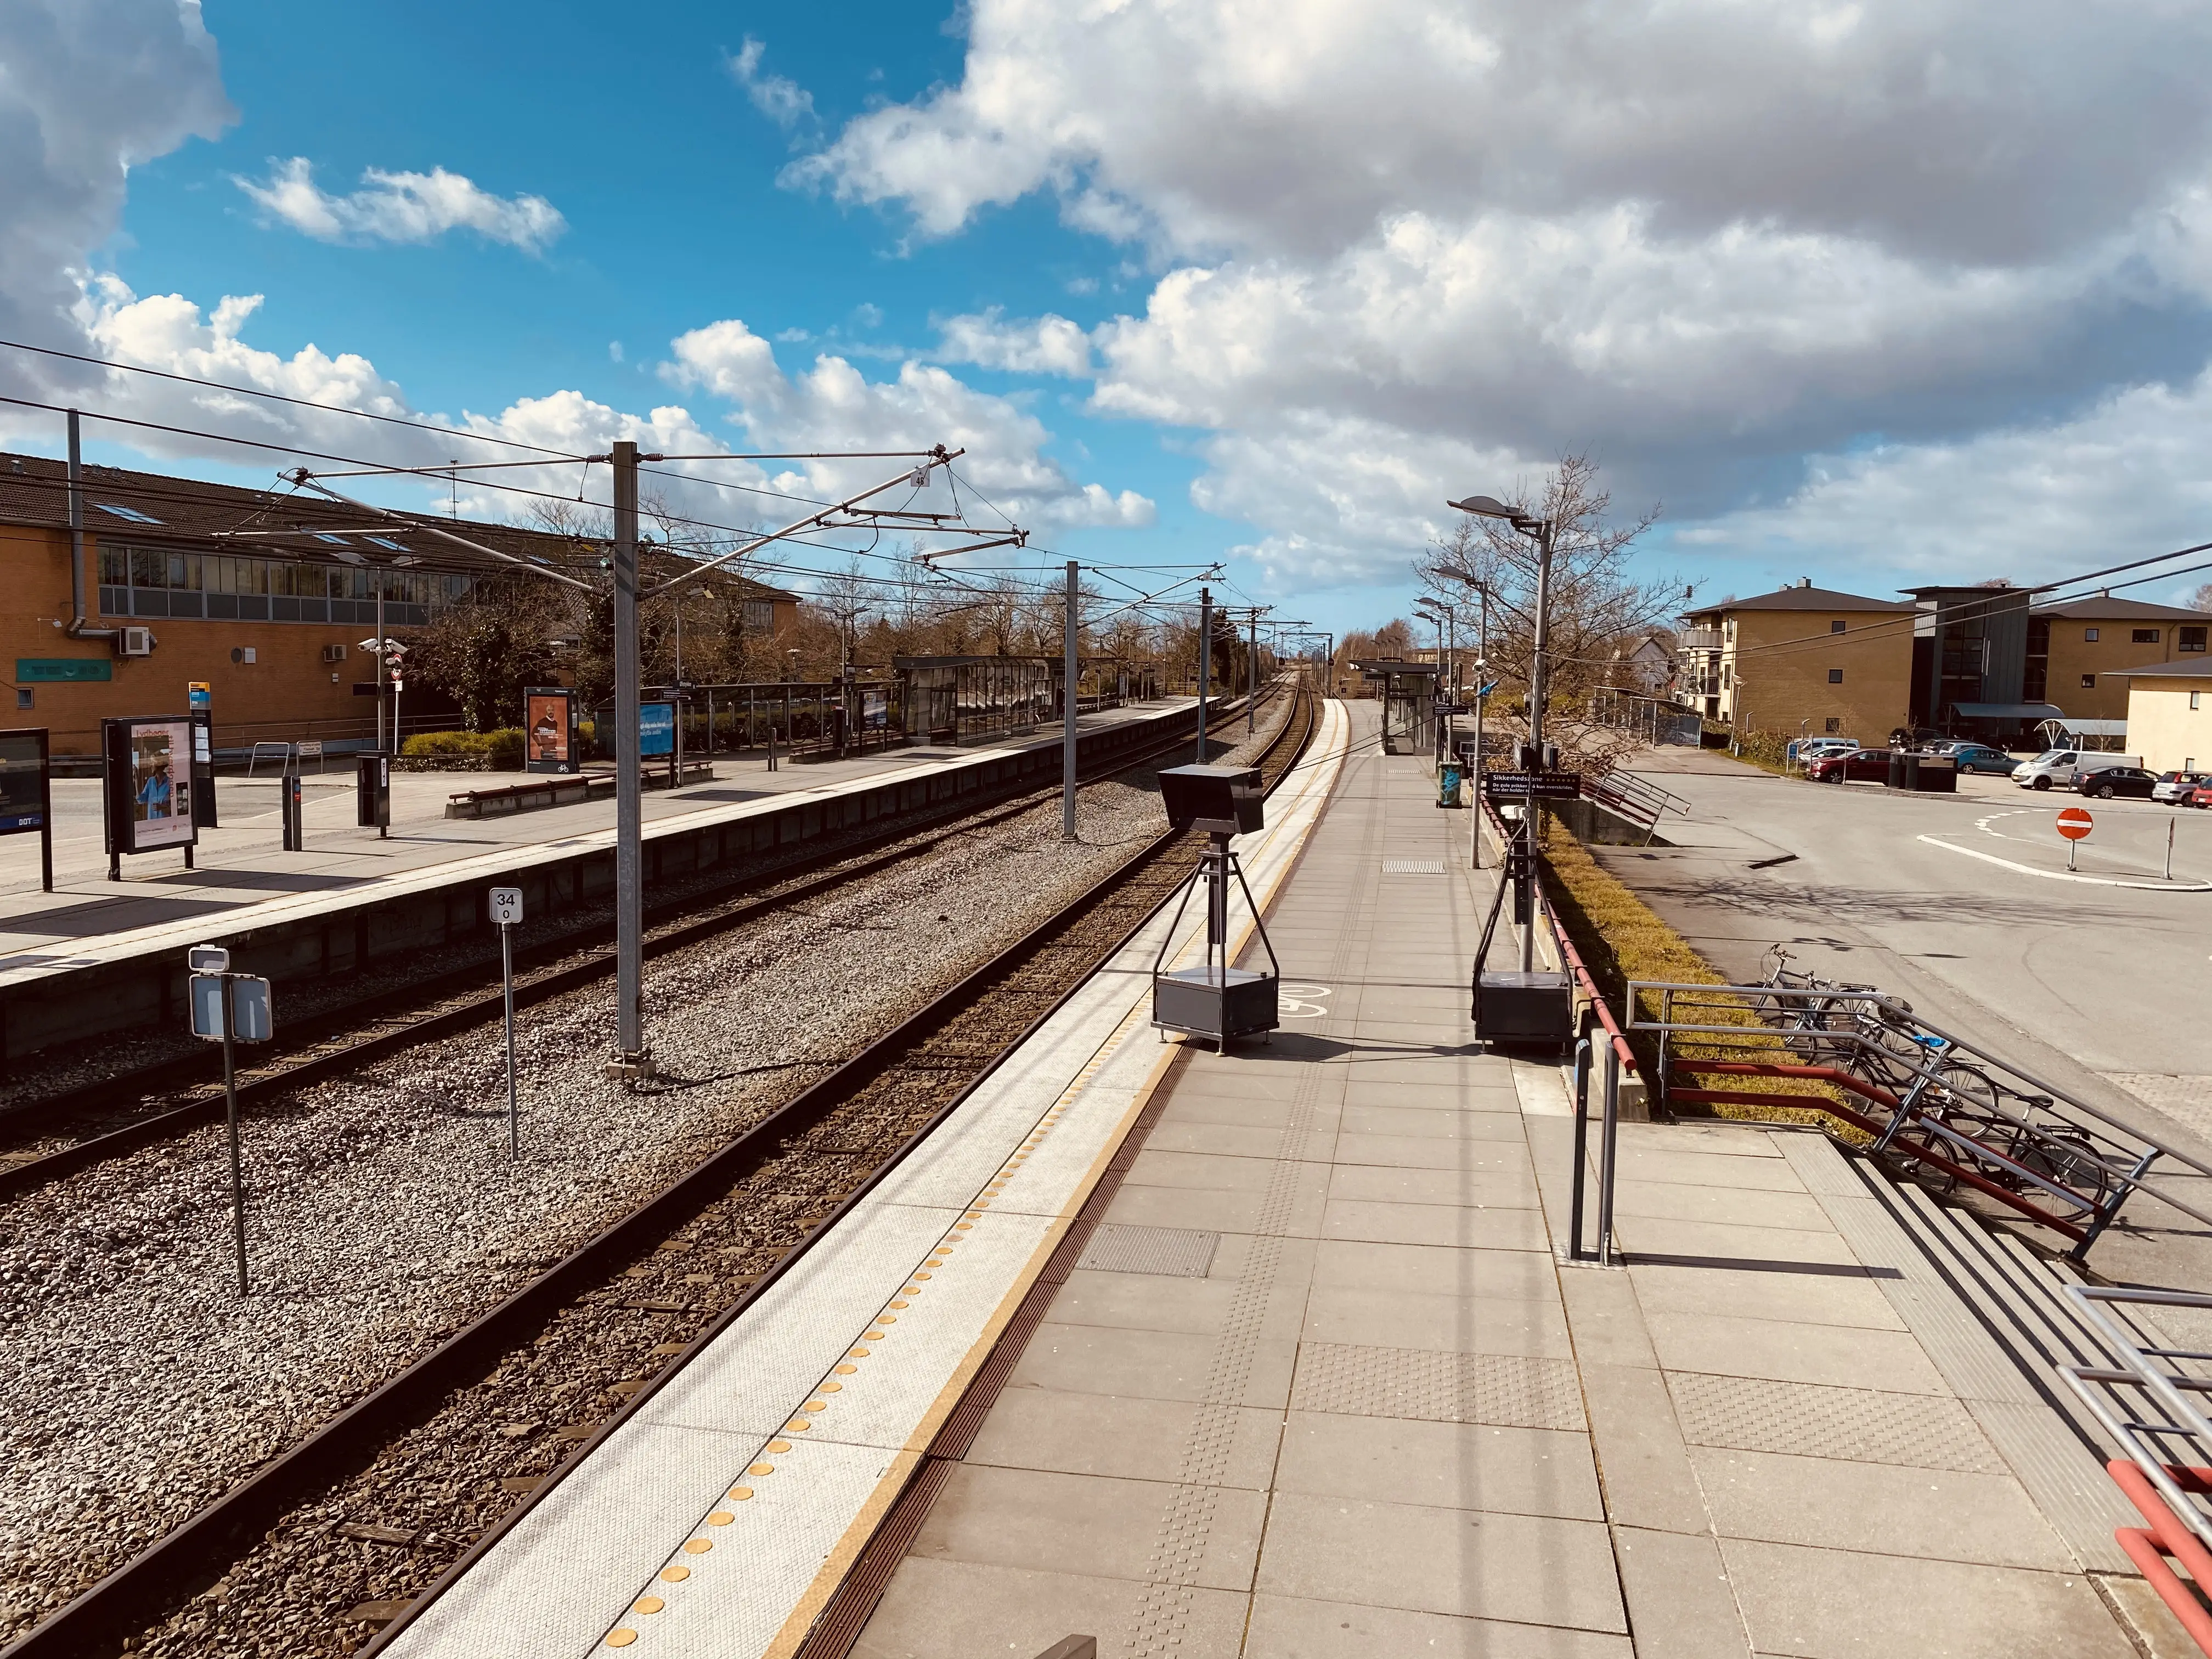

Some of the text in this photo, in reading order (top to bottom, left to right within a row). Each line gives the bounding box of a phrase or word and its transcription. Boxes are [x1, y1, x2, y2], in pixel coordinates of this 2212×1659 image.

[19, 817, 32, 826] DOT
[497, 894, 515, 906] 34
[503, 910, 510, 919] 0
